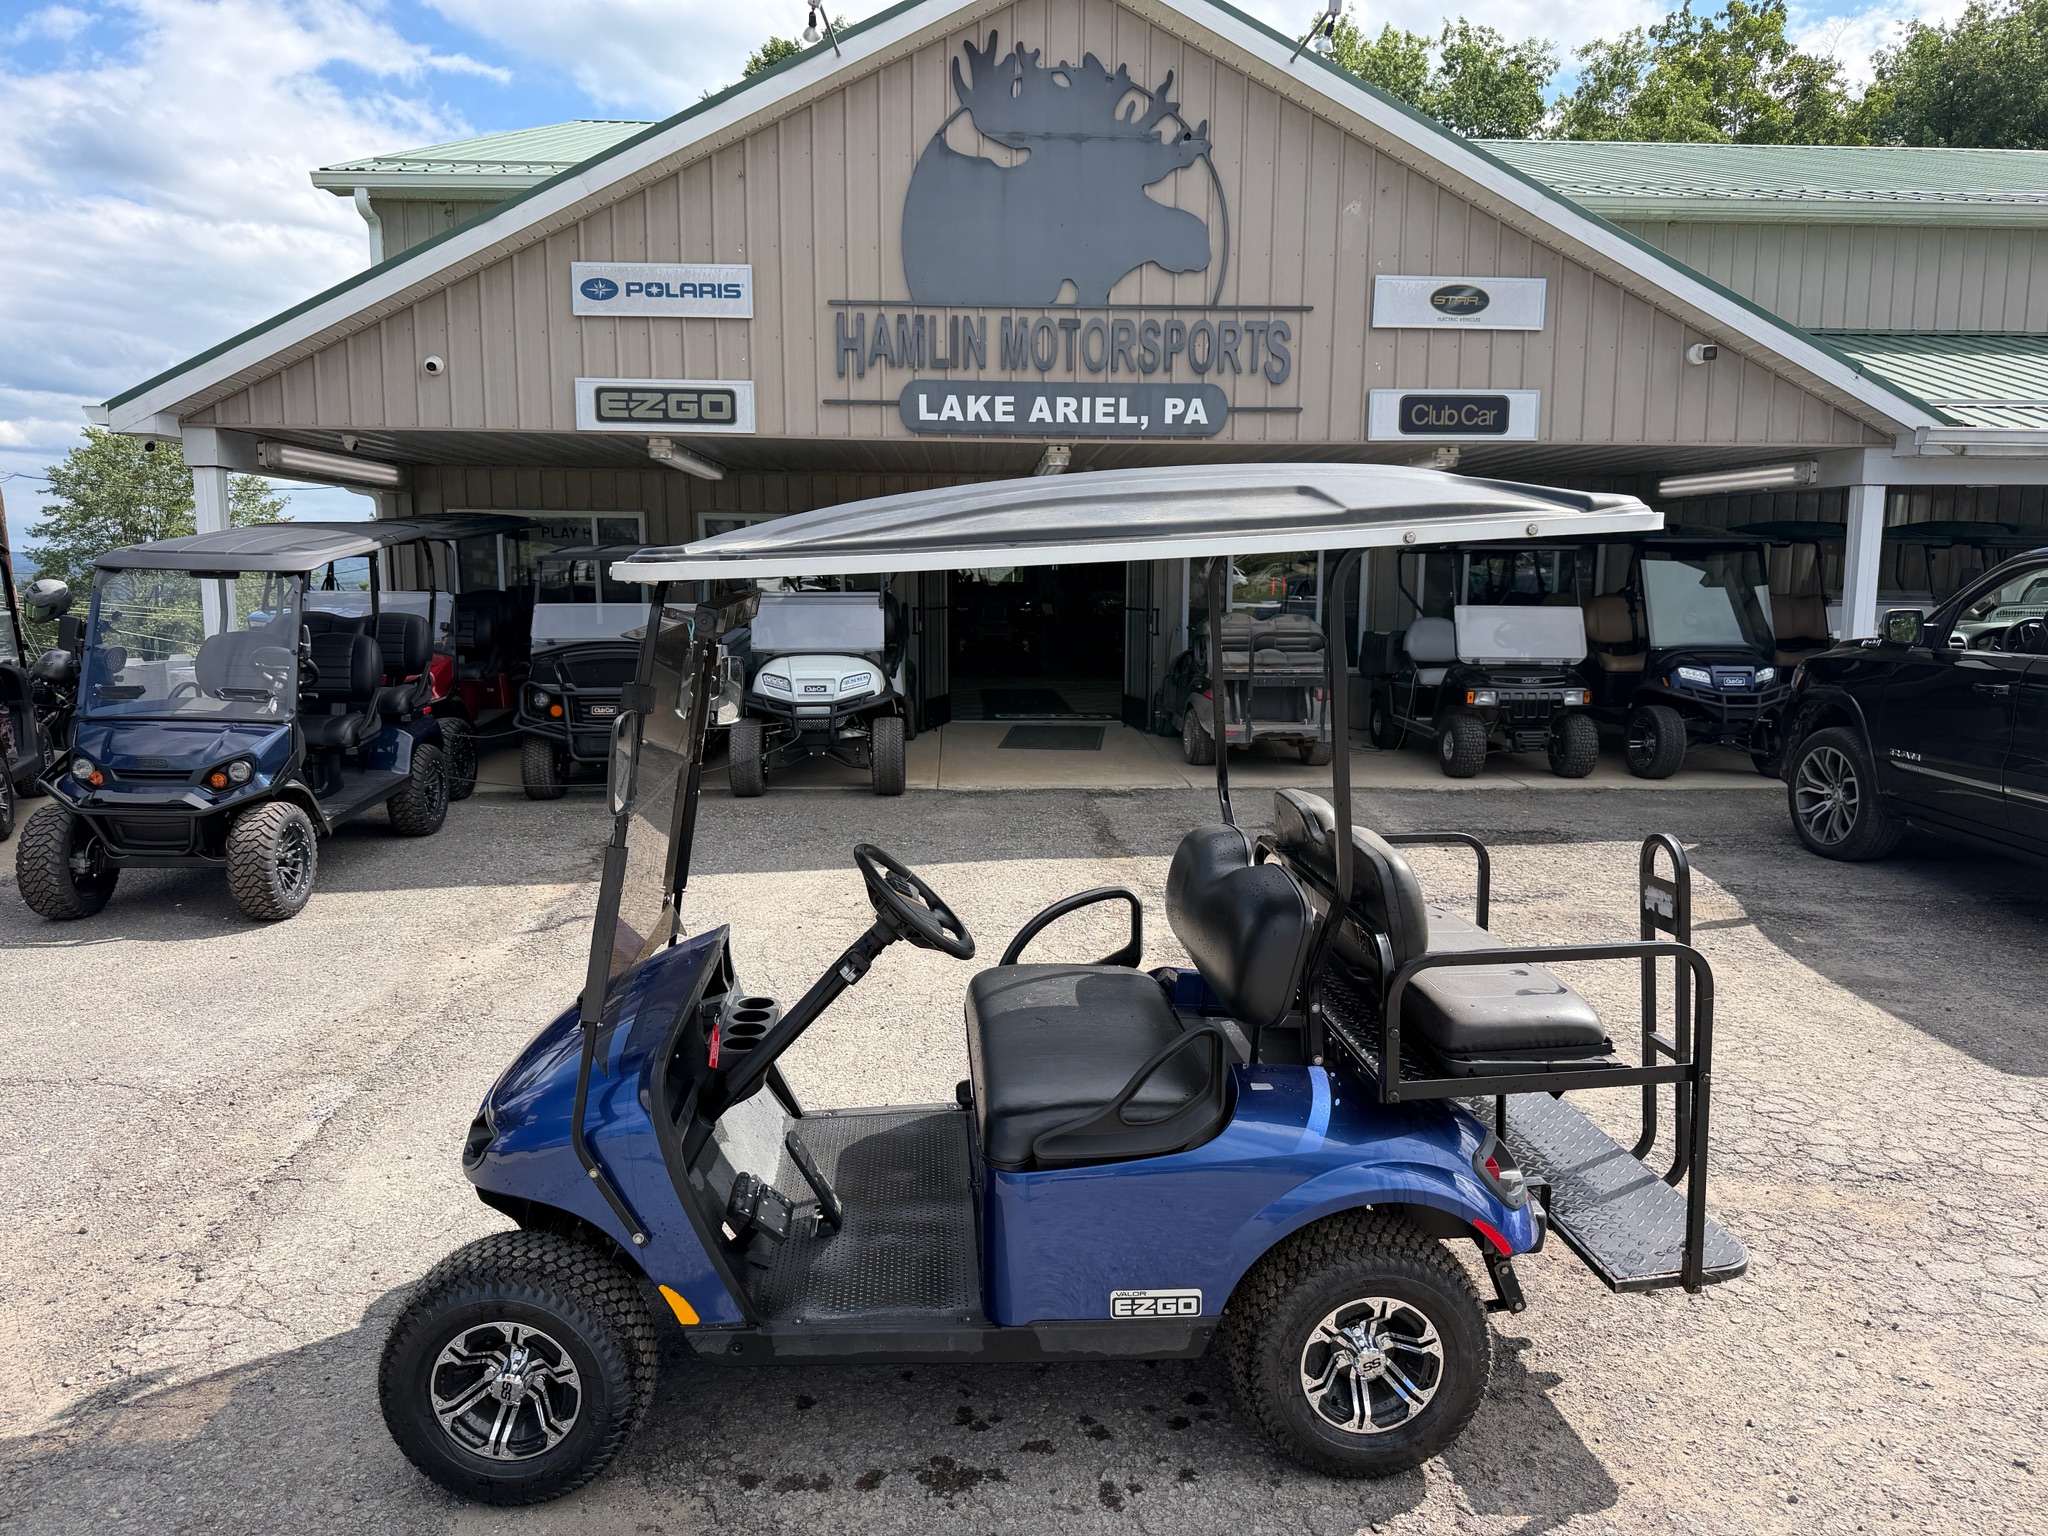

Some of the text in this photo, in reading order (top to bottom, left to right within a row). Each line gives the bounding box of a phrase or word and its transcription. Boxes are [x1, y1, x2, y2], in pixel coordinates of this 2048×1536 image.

[625, 281, 742, 299] POLARIS
[1433, 295, 1479, 305] STAR
[836, 312, 1292, 384] HAMLIN MOTORSPORTS
[600, 391, 733, 421] EZGO
[918, 394, 1209, 431] LAKE ARIEL, PA
[541, 526, 578, 539] PLAY
[1114, 1297, 1198, 1316] EZGO
[1363, 1357, 1381, 1372] SS
[501, 1380, 512, 1401] SS
